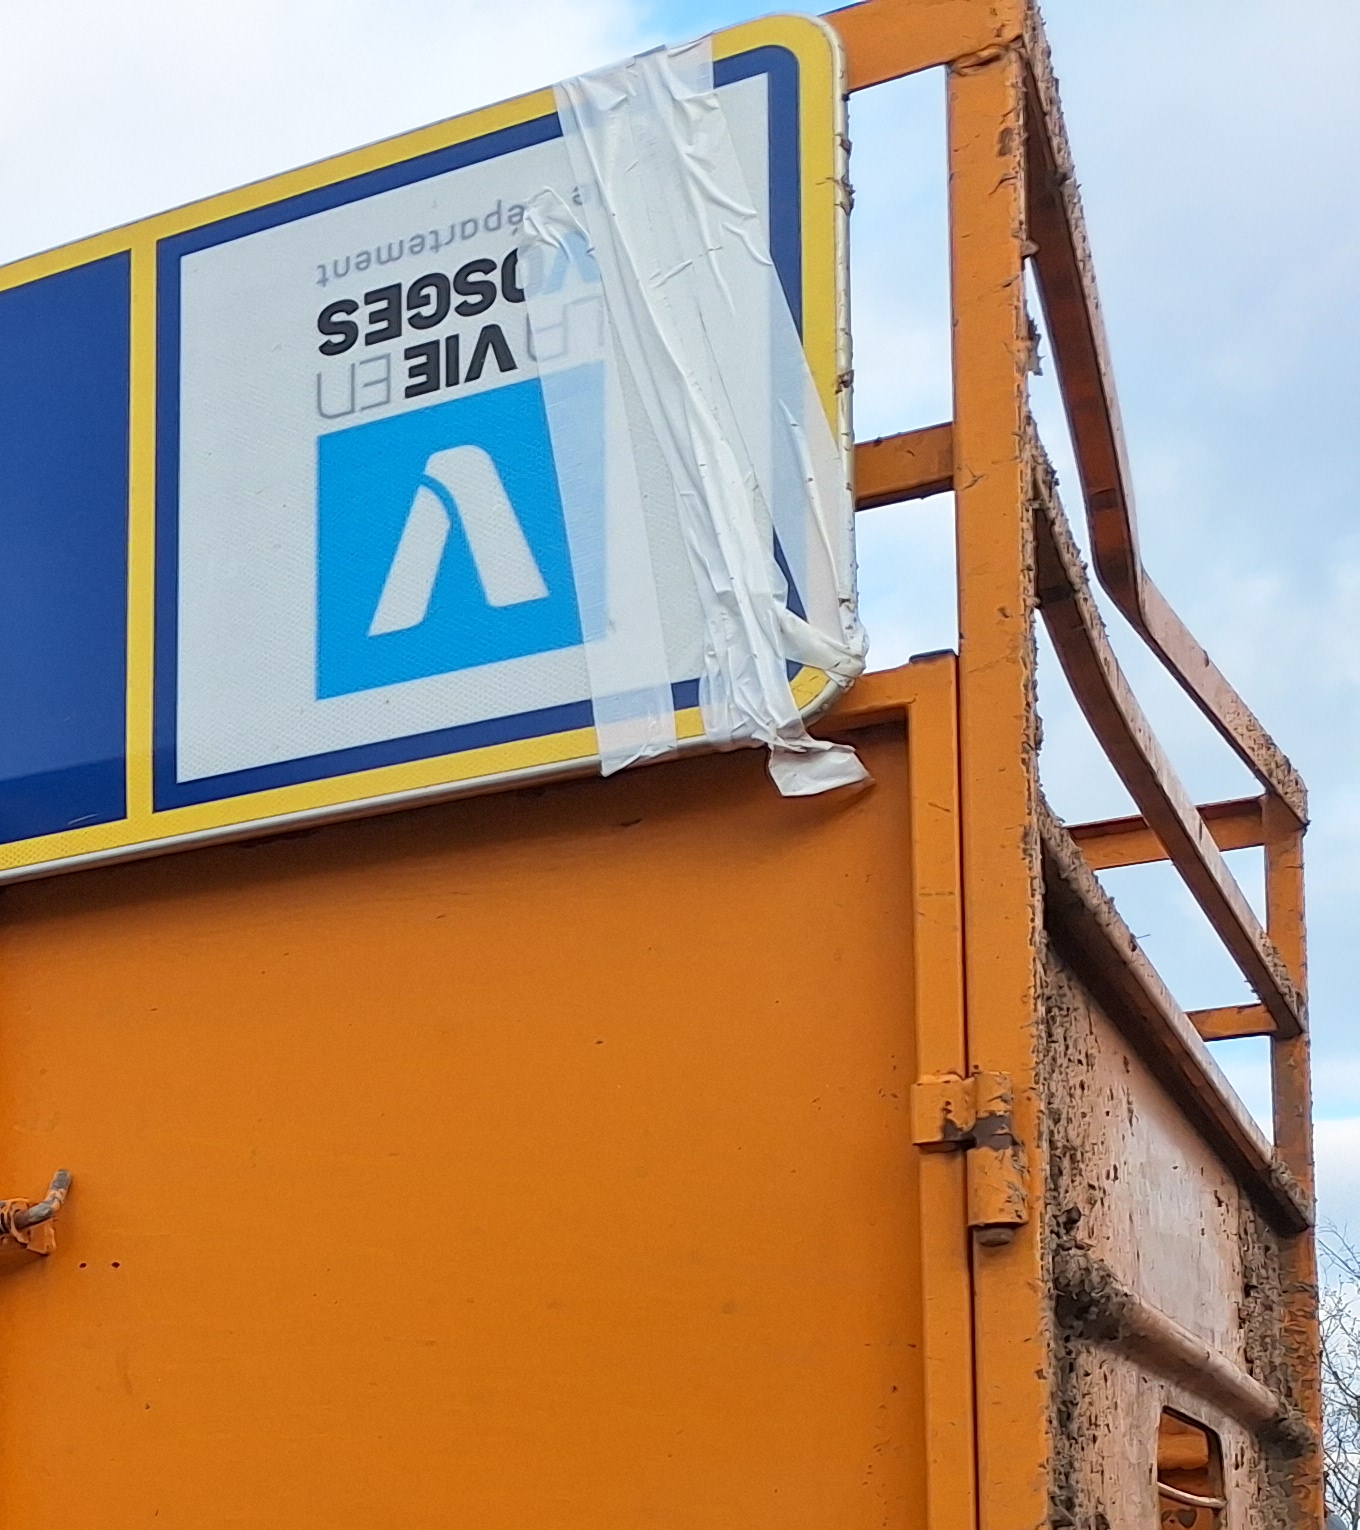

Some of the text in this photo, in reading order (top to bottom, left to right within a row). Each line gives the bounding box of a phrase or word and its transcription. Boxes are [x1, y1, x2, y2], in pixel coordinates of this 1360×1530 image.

[316, 200, 527, 288] épartement
[316, 352, 391, 420] EN
[403, 323, 519, 399] VIE
